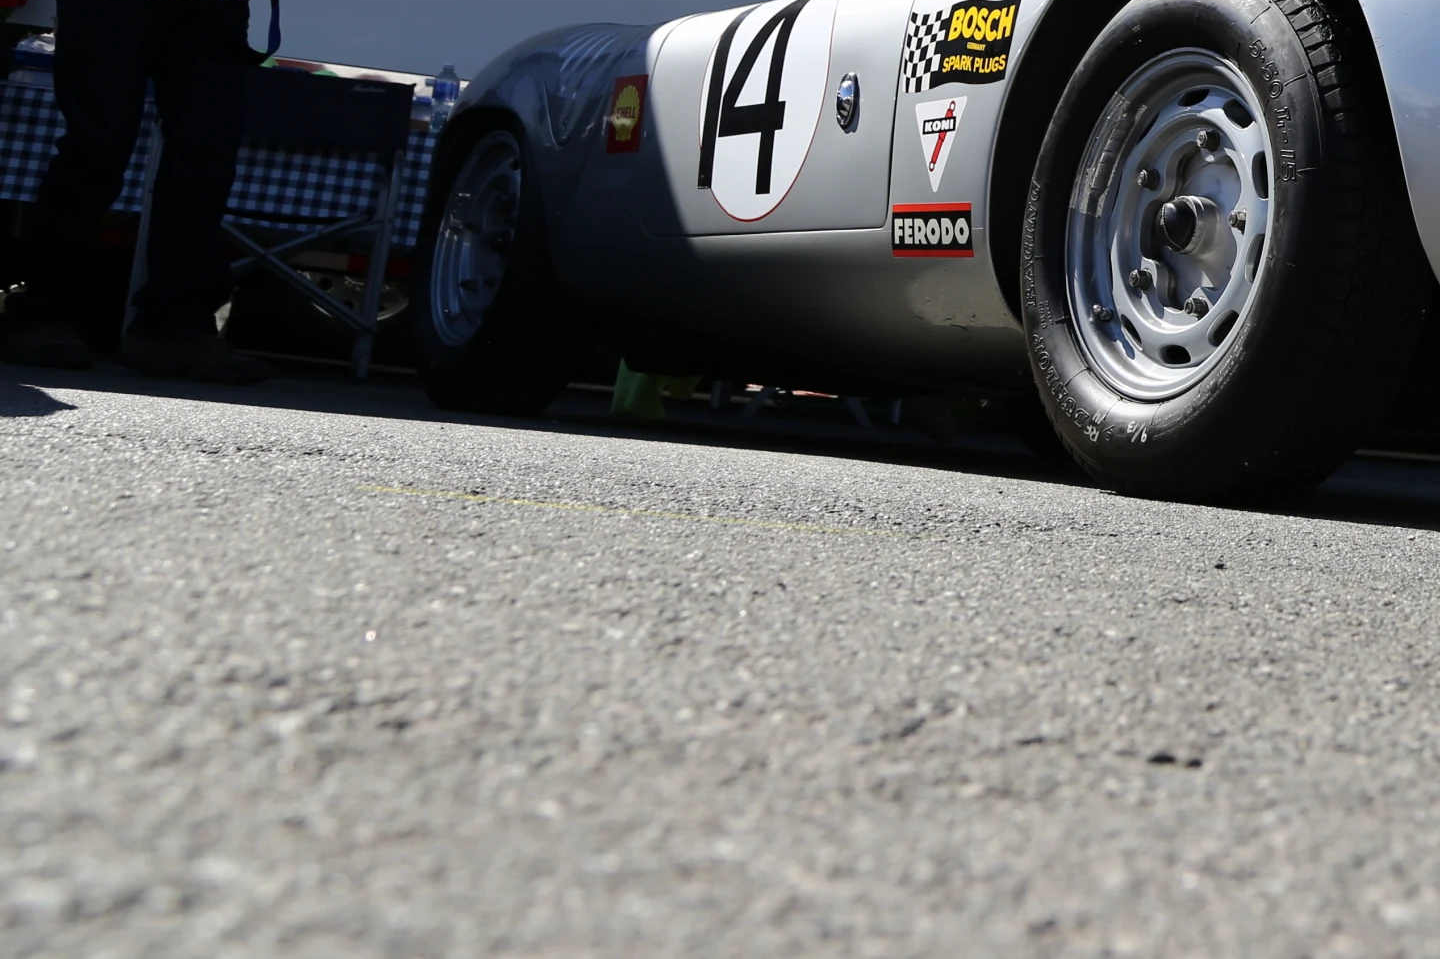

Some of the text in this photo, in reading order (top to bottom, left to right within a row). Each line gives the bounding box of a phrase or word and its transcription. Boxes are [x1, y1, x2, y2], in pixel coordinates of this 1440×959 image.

[947, 4, 1016, 42] BOSCH
[966, 41, 986, 51] GERMANY
[942, 54, 1007, 73] SPARK PLUGS
[1249, 37, 1284, 100] 5.50
[617, 106, 636, 119] SHELL
[924, 118, 954, 133] KONI
[894, 217, 970, 245] FERODO
[1023, 176, 1042, 308] RACING
[1032, 334, 1090, 428] DUNLOP
[1083, 424, 1100, 442] RF
[1126, 421, 1148, 443] 9/13
